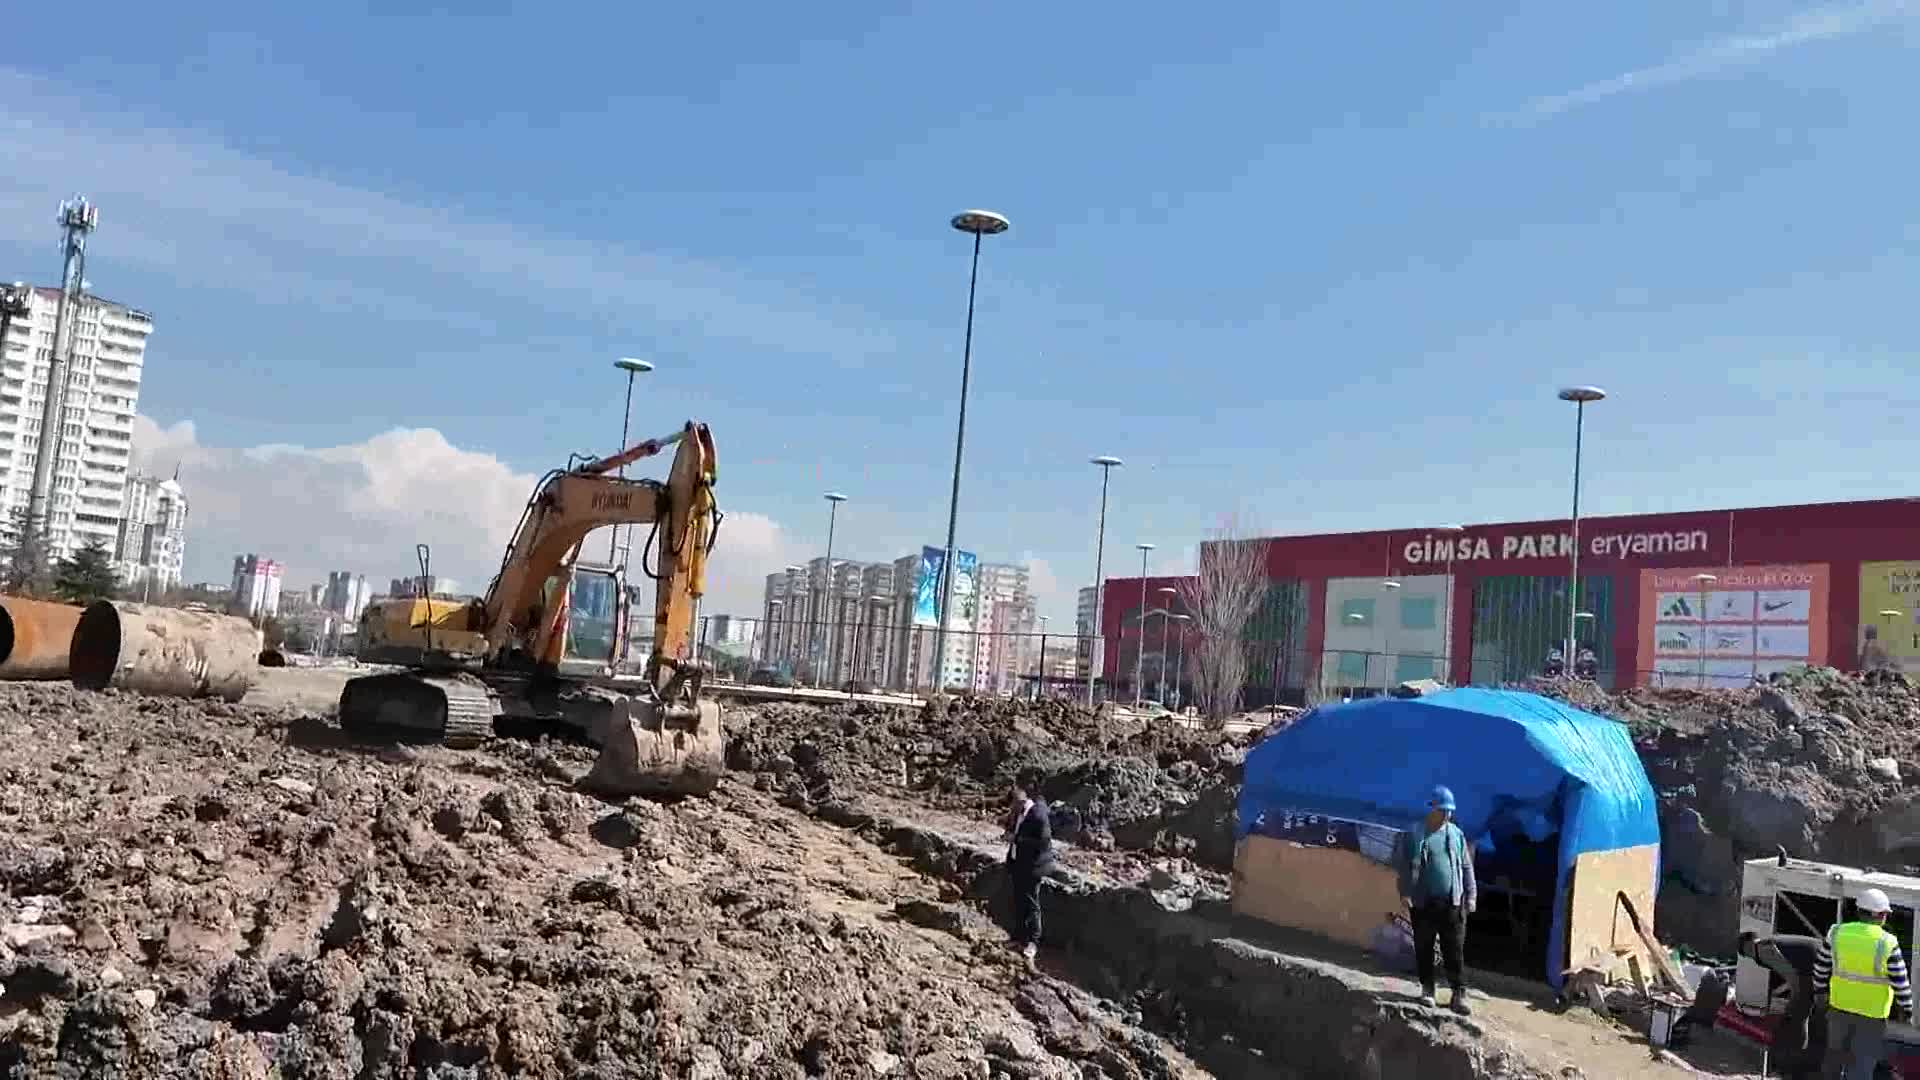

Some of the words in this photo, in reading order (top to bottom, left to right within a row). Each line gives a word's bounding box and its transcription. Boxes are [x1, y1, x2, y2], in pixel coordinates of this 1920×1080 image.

[1403, 533, 1491, 563] GİMSA
[1502, 533, 1576, 560] PARK
[1591, 529, 1708, 559] eryaman
